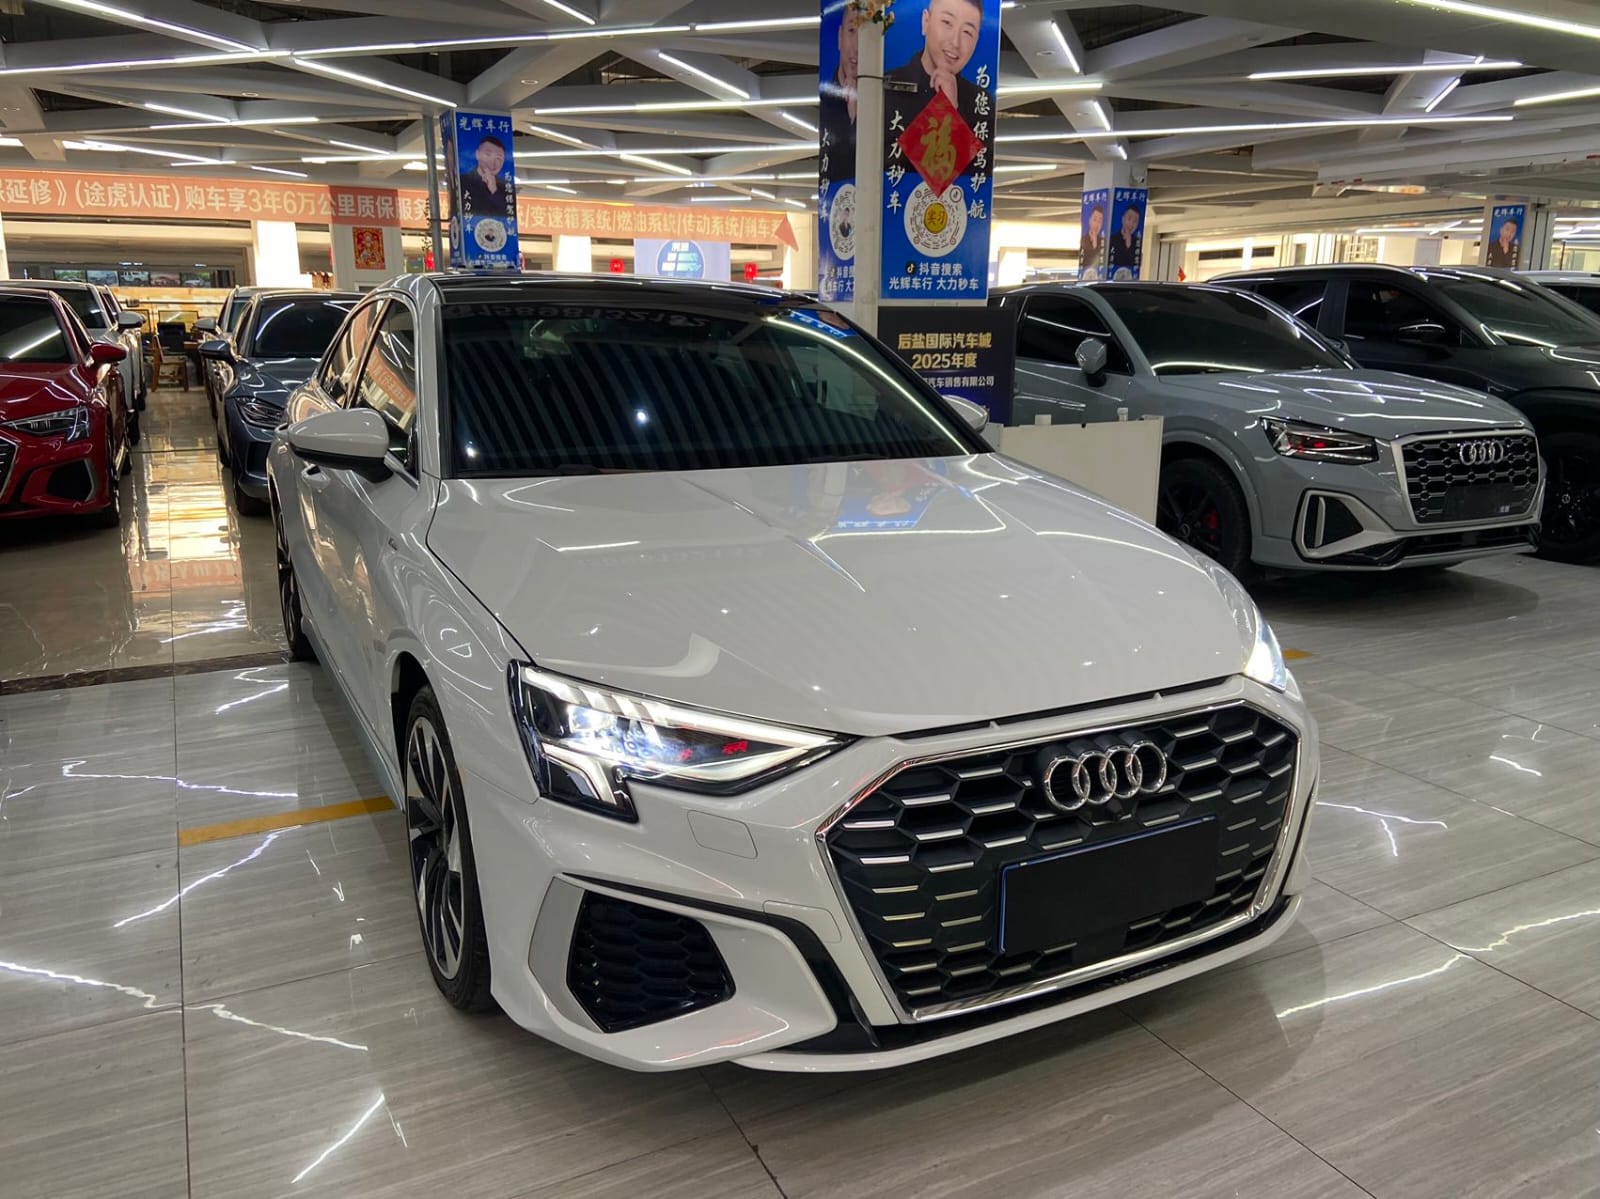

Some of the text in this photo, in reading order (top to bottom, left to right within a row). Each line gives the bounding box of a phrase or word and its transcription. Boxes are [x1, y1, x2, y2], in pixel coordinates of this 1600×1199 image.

[921, 113, 957, 180] 福
[919, 263, 963, 276] 抖音搜索
[888, 276, 979, 290] 光辉车行 大力秒车
[898, 332, 992, 349] 后盐国际汽车城
[911, 352, 978, 369] 2025年度
